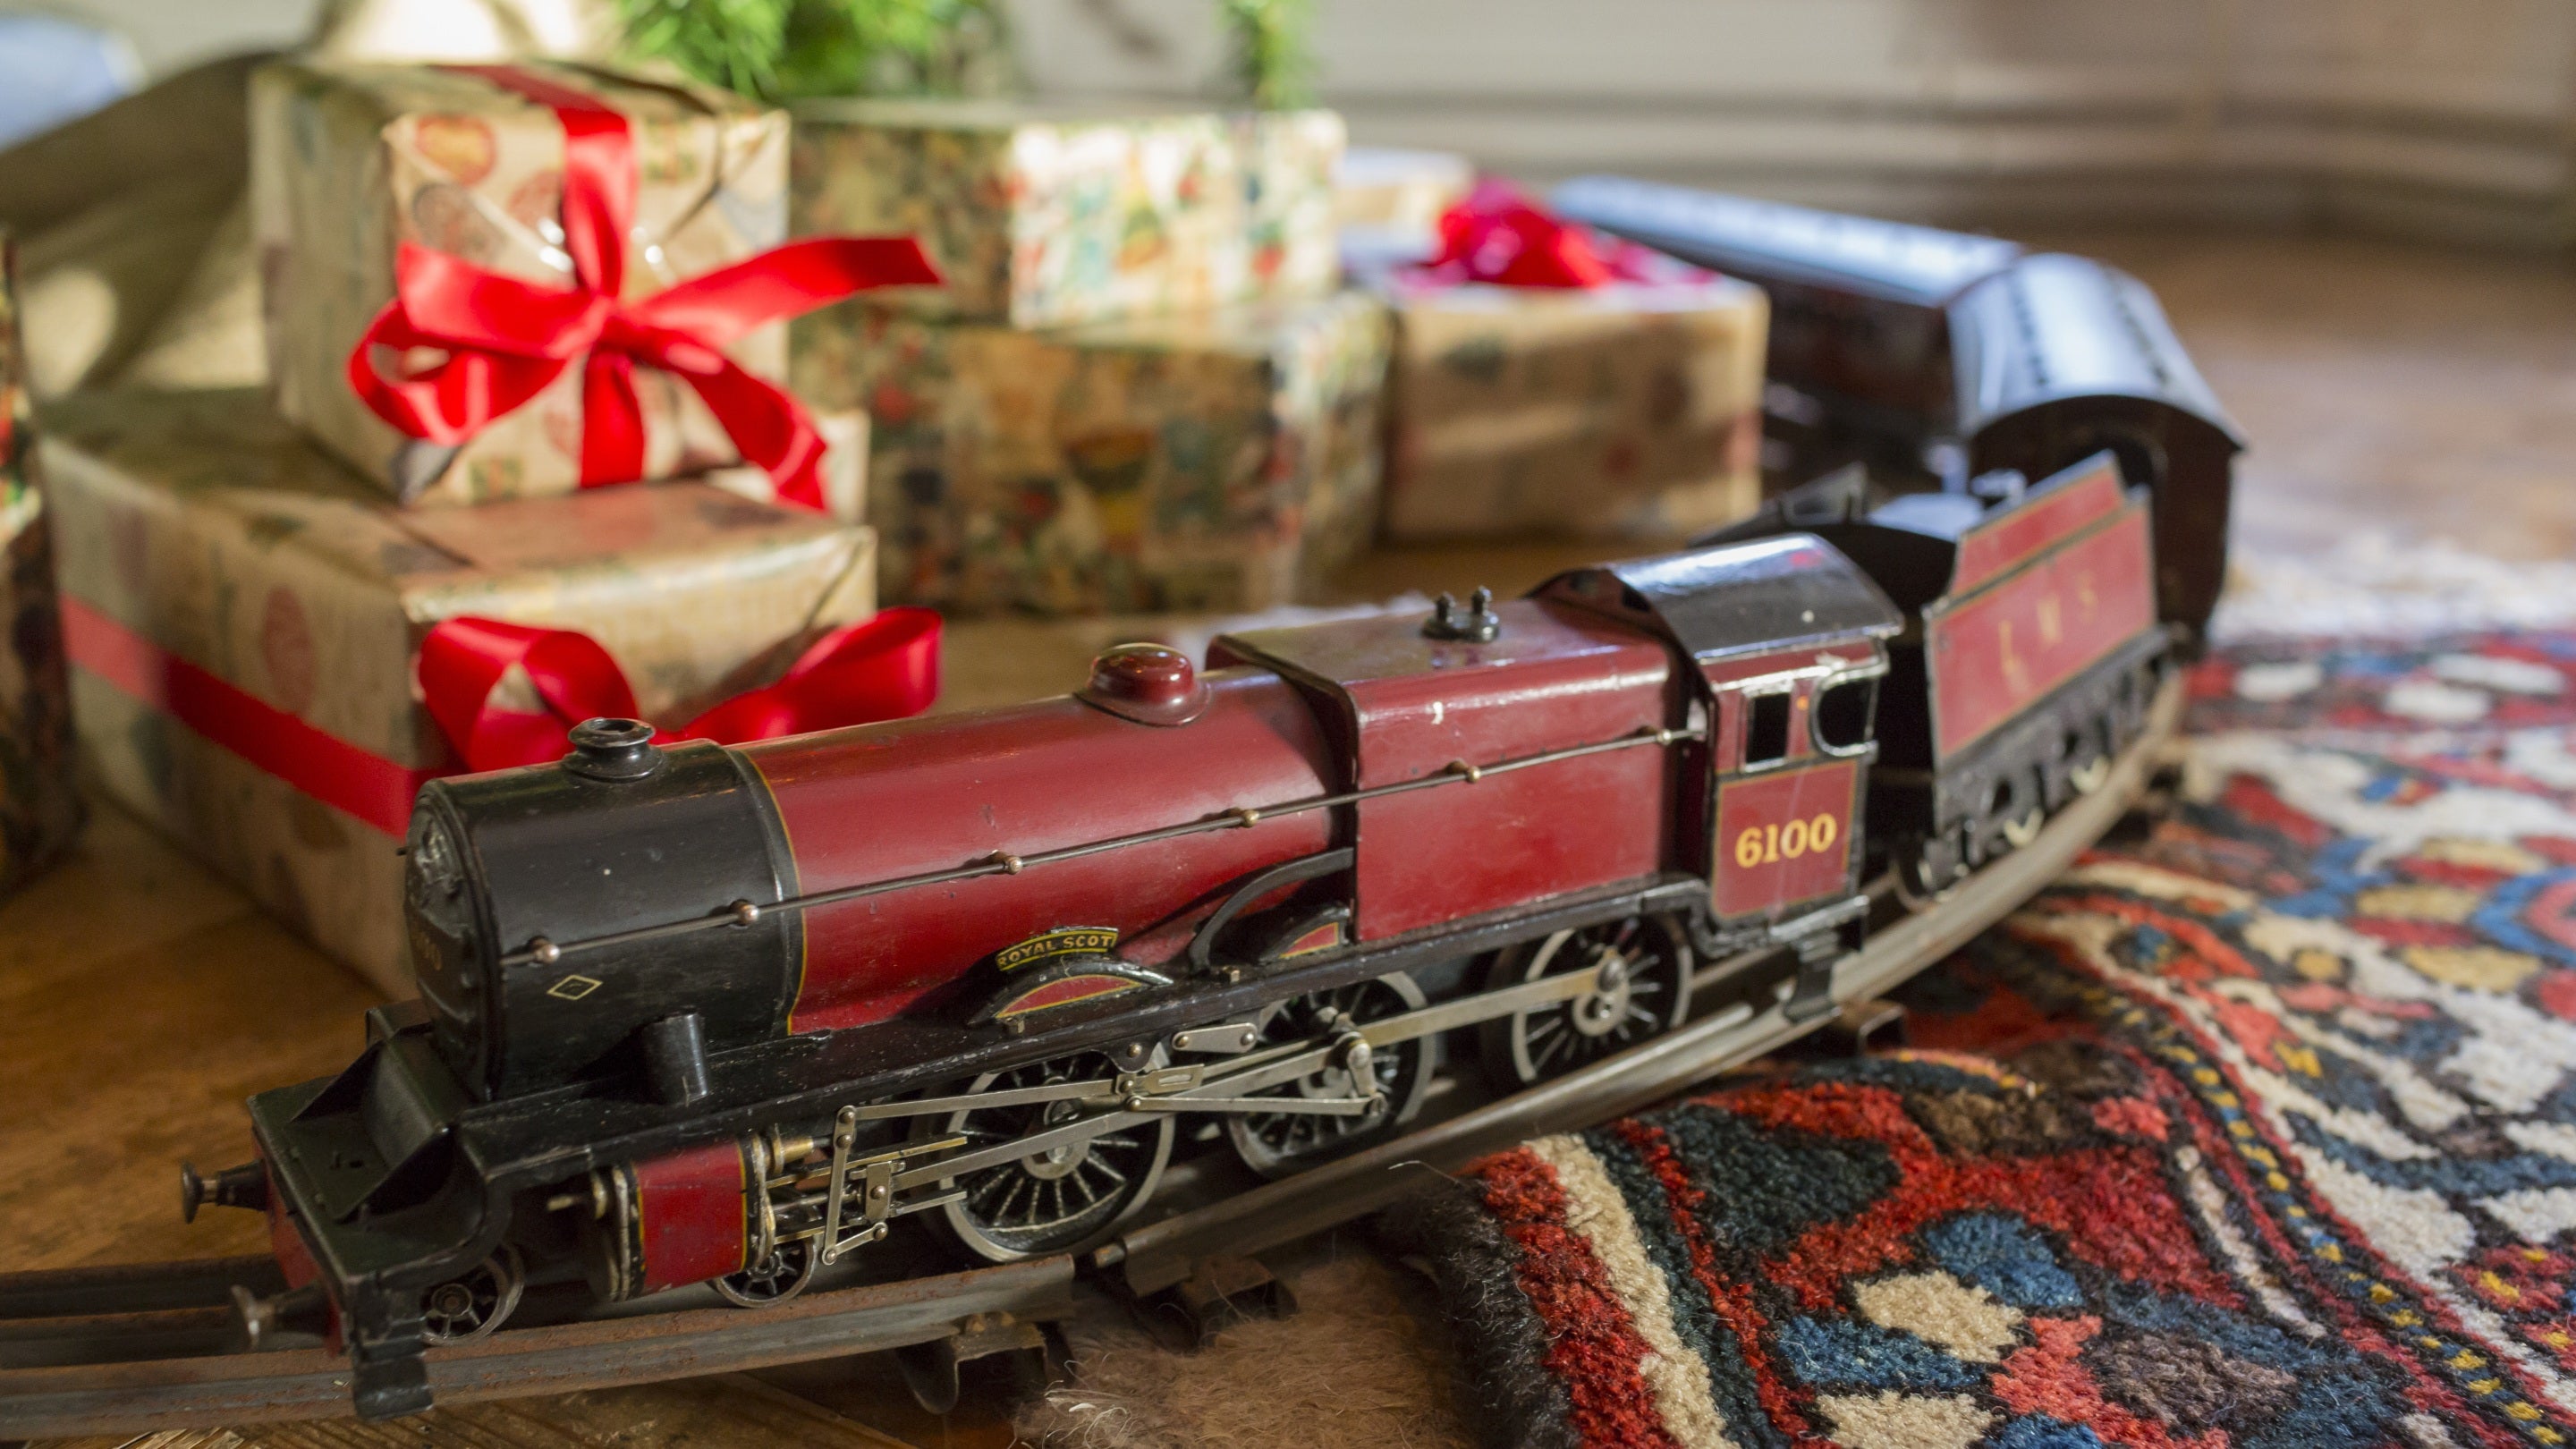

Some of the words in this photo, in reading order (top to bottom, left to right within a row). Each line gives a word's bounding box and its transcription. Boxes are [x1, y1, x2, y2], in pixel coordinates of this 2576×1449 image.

[1734, 812, 1837, 869] 6100
[997, 940, 1056, 966] ROYAL
[1063, 936, 1112, 948] SCOT
